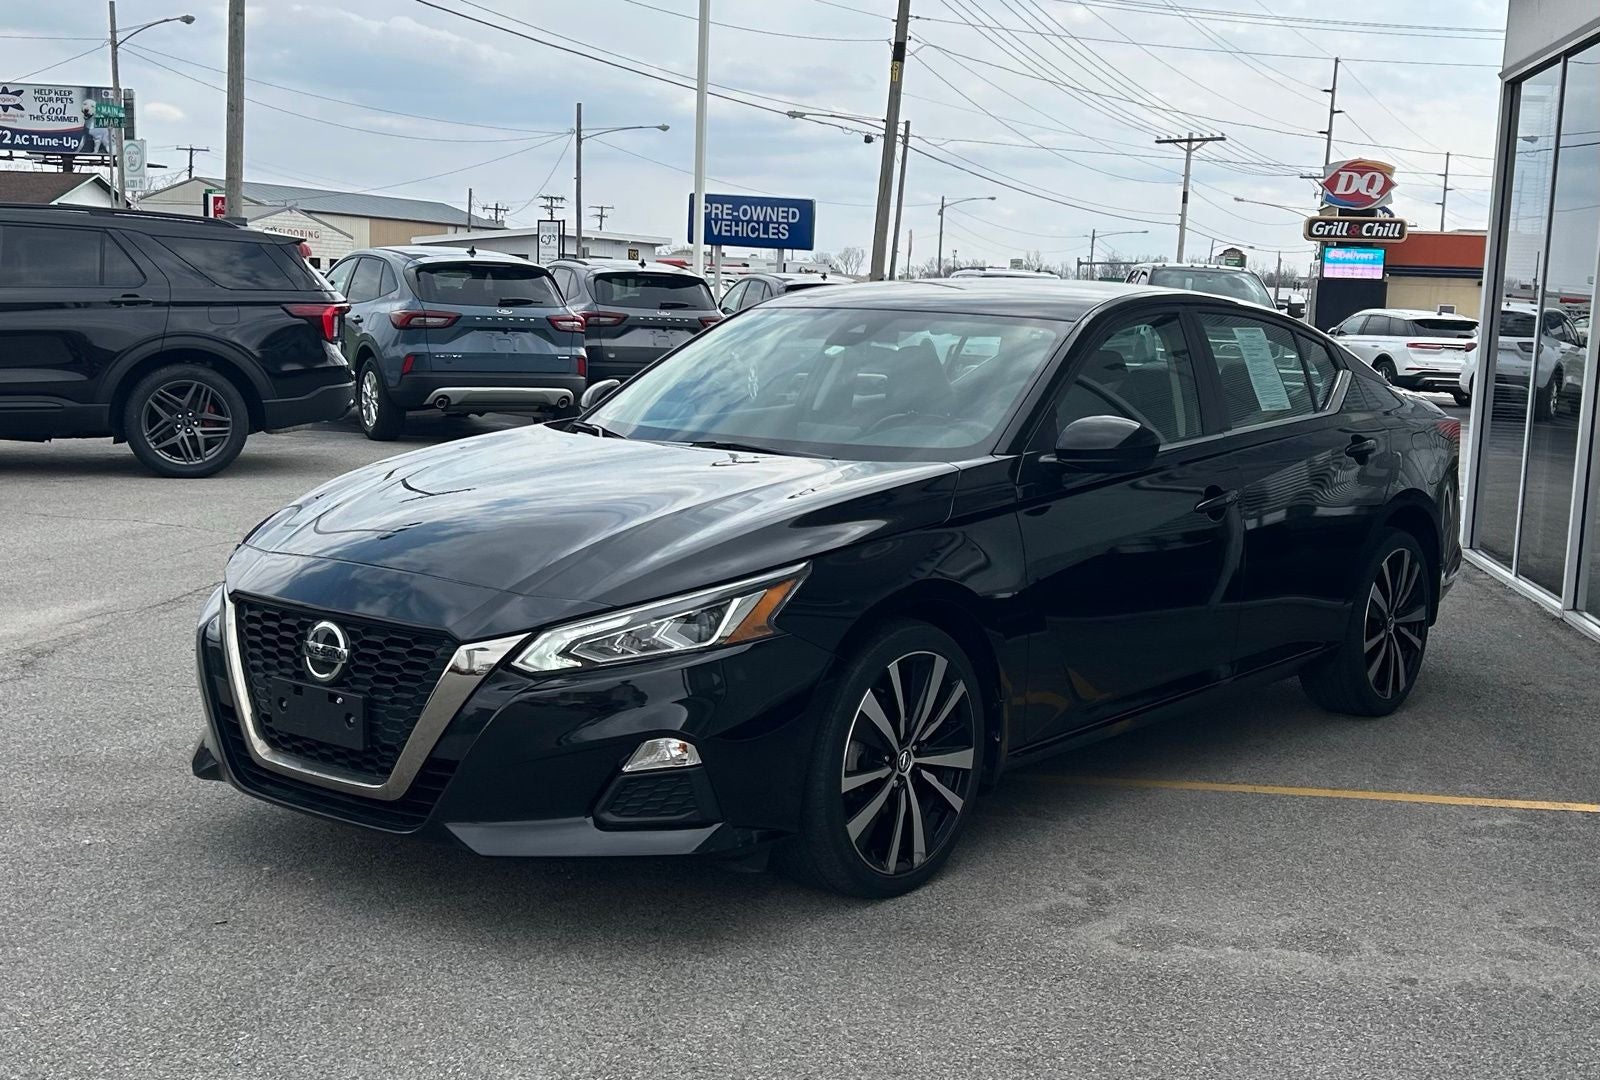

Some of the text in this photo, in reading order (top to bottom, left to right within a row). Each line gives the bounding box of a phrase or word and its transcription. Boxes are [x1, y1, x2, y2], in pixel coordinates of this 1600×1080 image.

[39, 103, 67, 115] Cool
[29, 114, 45, 122] THIS
[46, 115, 79, 123] SUMMER
[13, 134, 30, 145] AC
[31, 135, 79, 149] Tune-Up
[1334, 172, 1384, 199] DQ
[704, 203, 800, 223] PRE-OWNED
[711, 220, 789, 240] VEHICLES
[1312, 221, 1402, 237] Grill & Chill
